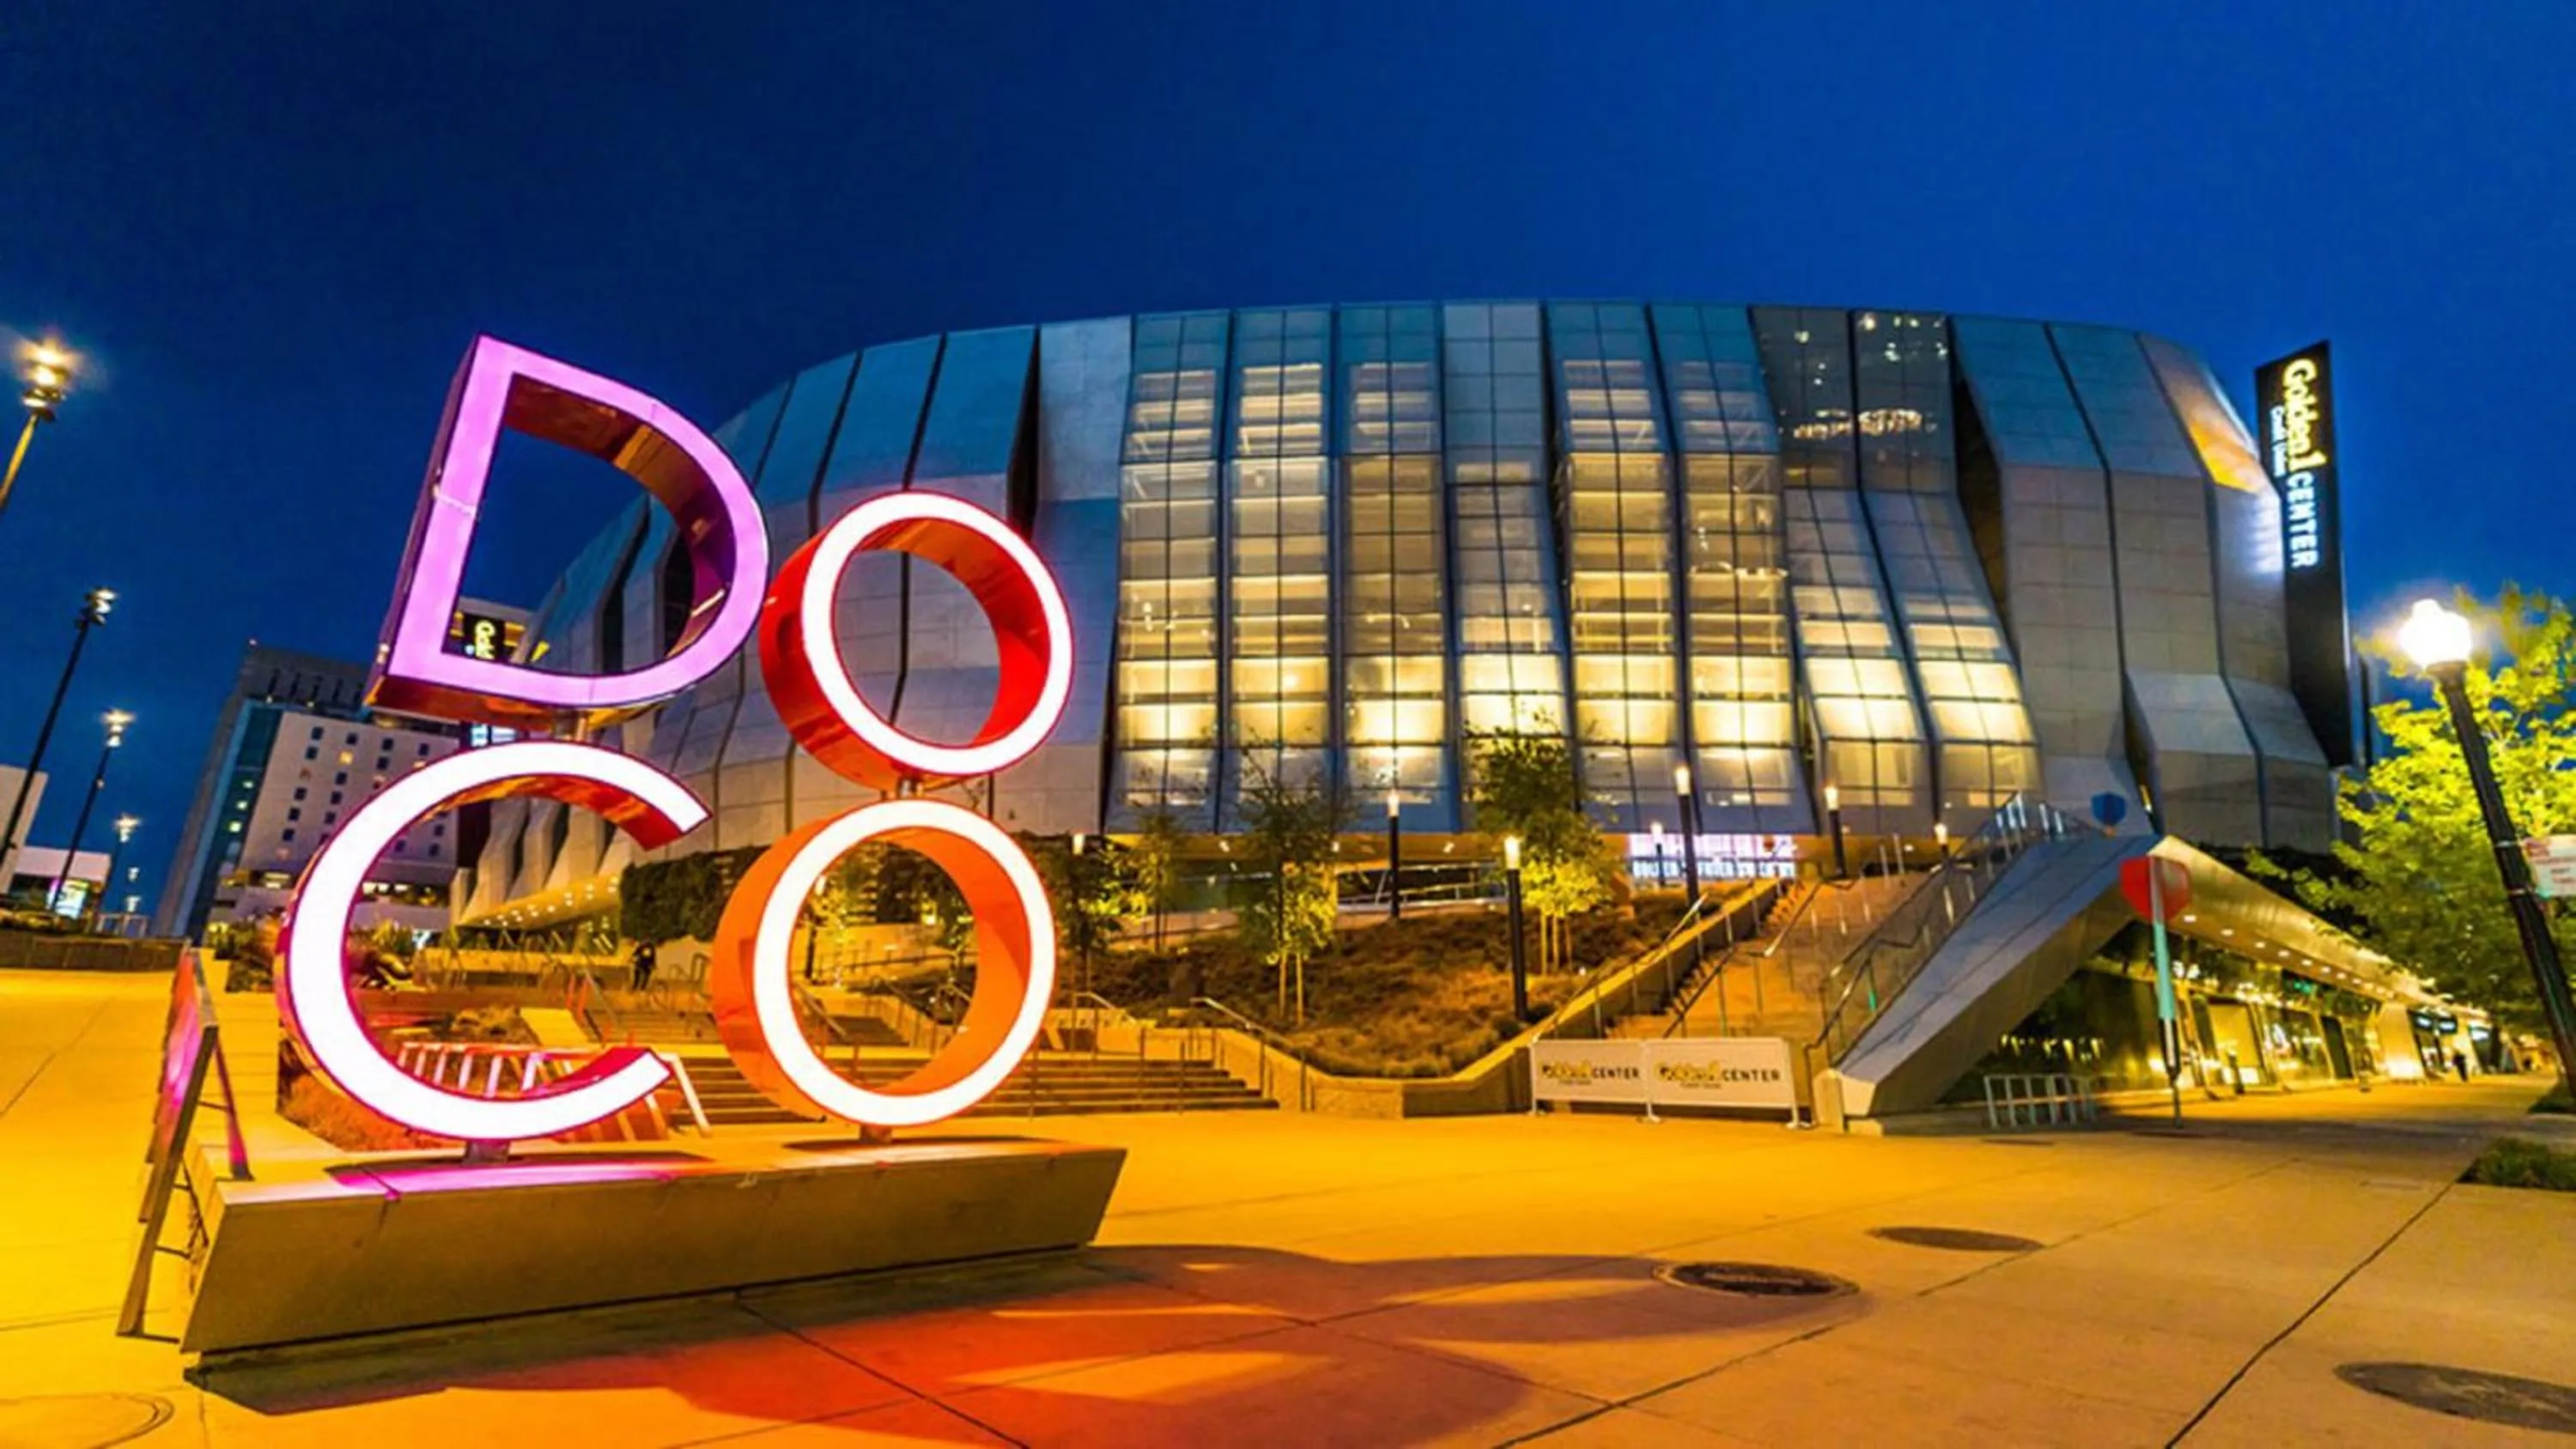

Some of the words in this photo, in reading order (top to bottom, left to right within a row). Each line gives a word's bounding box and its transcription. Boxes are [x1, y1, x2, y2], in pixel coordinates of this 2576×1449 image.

[2287, 471, 2319, 568] CENTER
[1592, 1065, 1639, 1080] CENTER
[1722, 1068, 1781, 1083] CENTER
